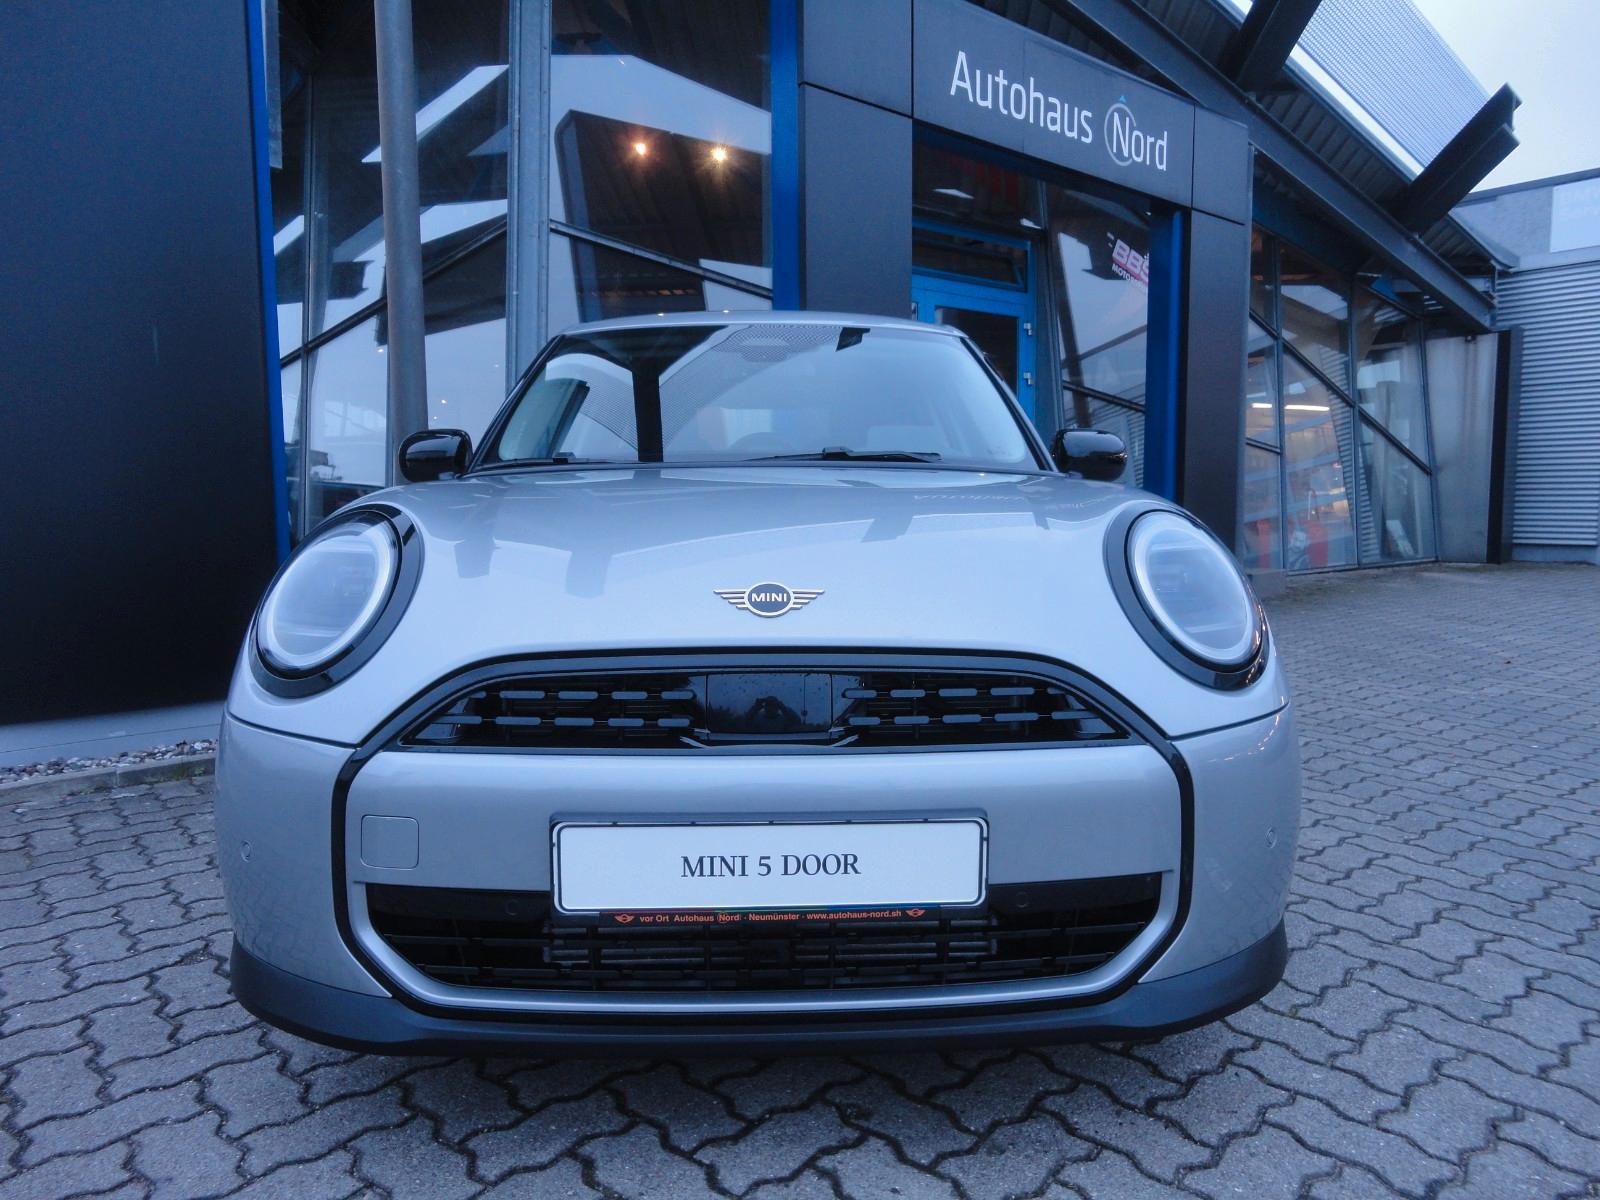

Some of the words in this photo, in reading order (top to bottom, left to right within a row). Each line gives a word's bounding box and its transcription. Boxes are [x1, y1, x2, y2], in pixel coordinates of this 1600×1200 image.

[951, 50, 1093, 144] Autohaus
[1112, 110, 1168, 172] Nord
[751, 592, 788, 602] MINI
[680, 855, 749, 877] MINI
[757, 855, 772, 877] 5
[780, 853, 862, 876] DOOR
[639, 915, 653, 923] vor
[655, 914, 669, 922] Ort
[674, 914, 715, 922] Autohaus
[719, 913, 740, 921] Nord
[748, 912, 800, 921] Neumünster
[806, 909, 902, 920] www.autohaus-nord.sh
